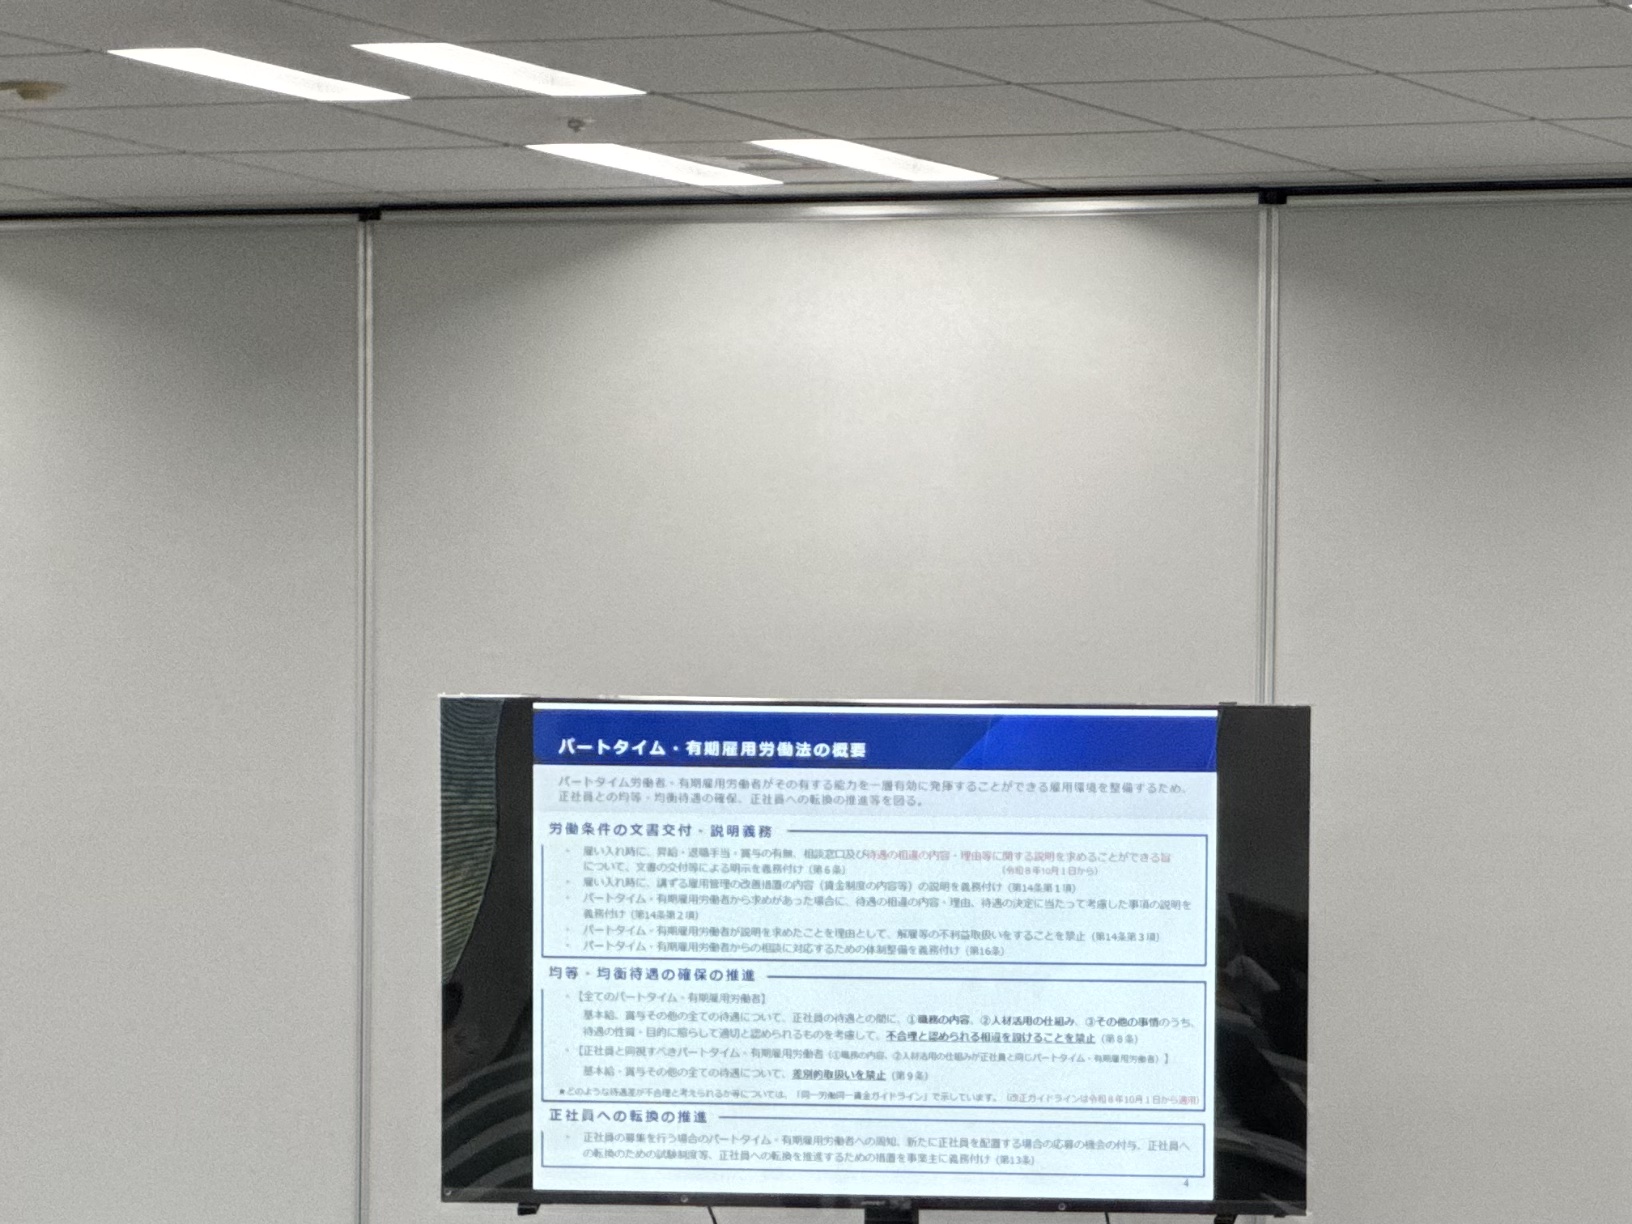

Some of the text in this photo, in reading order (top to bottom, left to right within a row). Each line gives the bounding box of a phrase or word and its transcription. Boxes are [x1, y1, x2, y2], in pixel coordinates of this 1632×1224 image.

[558, 738, 867, 758] パートタイム・有期雇用労働法の概要
[549, 822, 773, 838] 労働条件の文書交付・説明義務
[549, 966, 756, 982] 均等・均衡待遇の確保の推進
[549, 1108, 708, 1124] 正社員への転換の推進
[1183, 1178, 1189, 1188] 4
